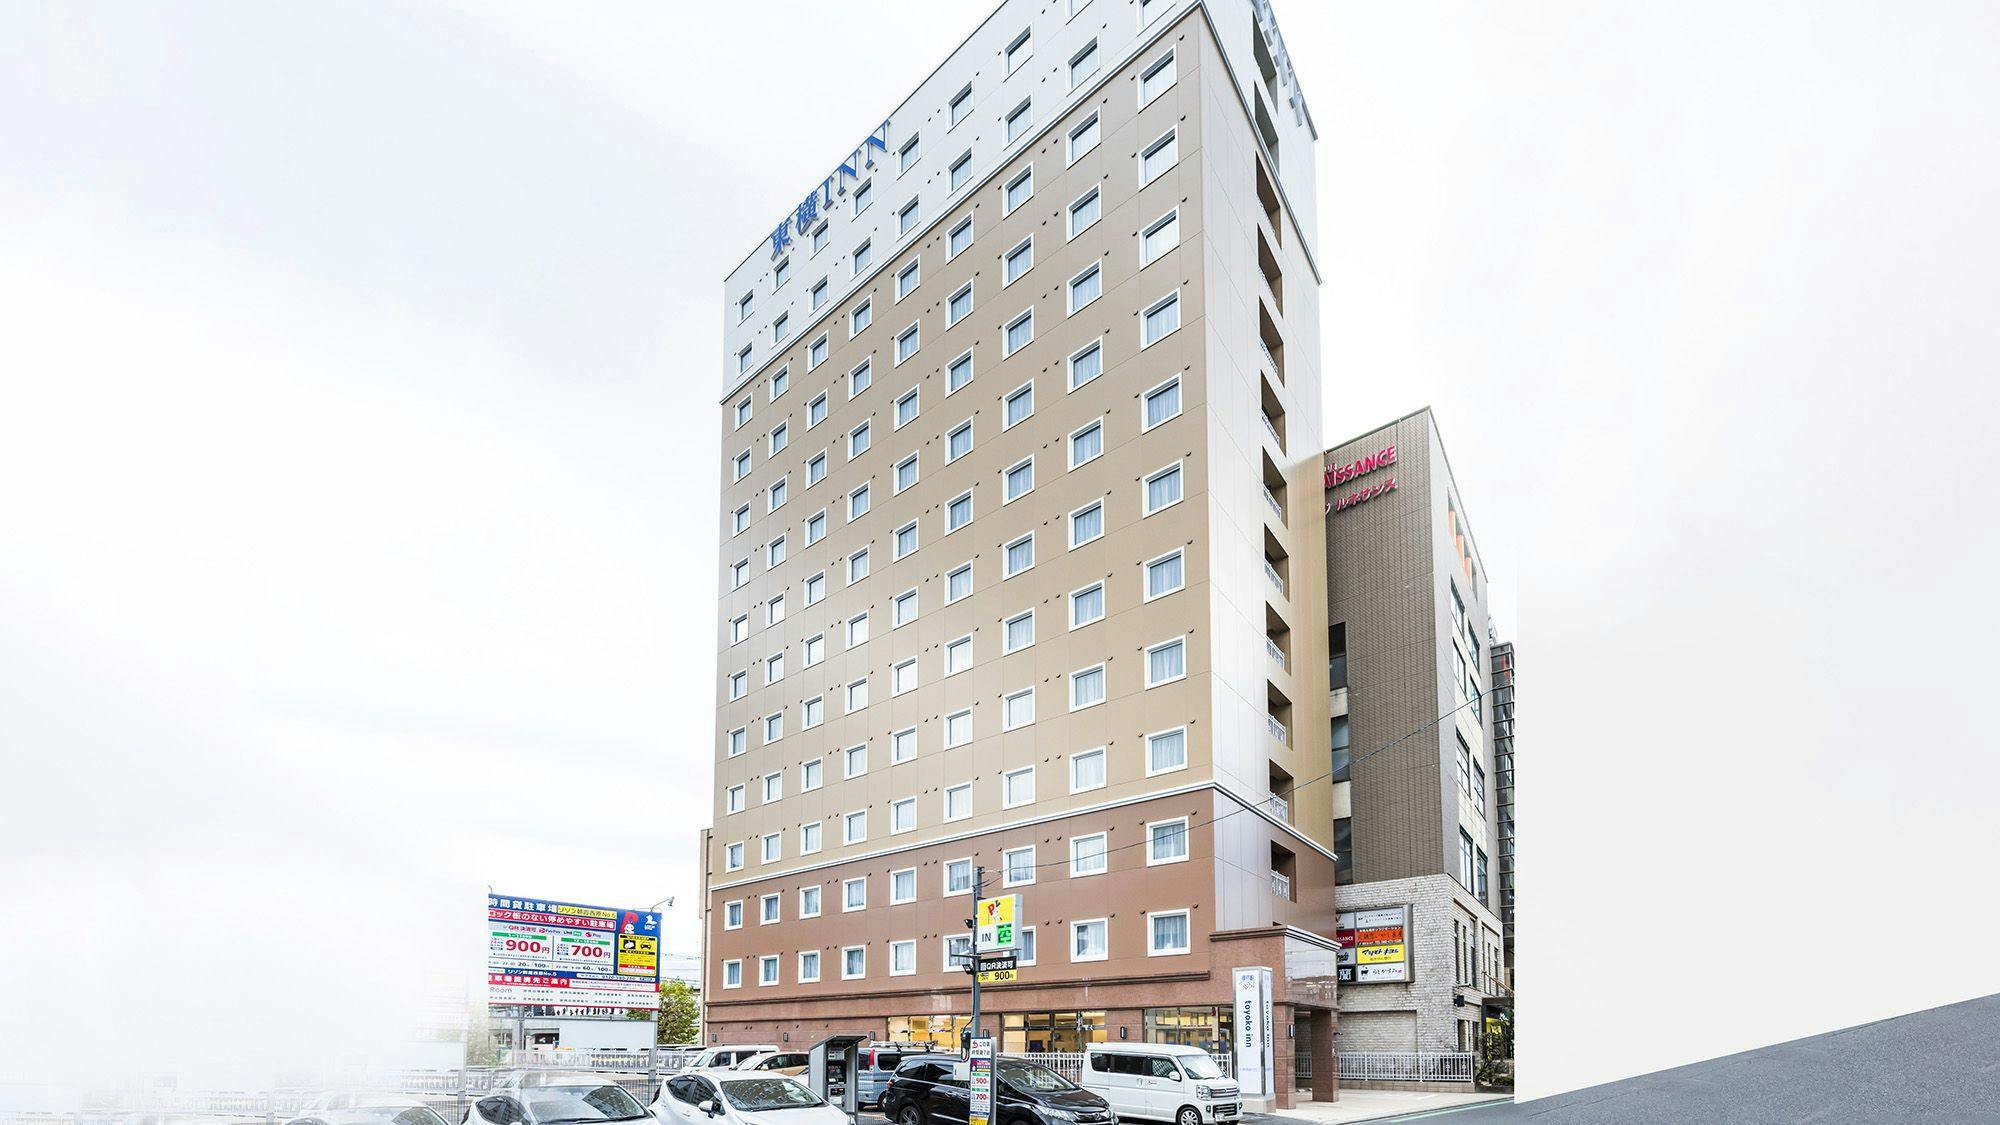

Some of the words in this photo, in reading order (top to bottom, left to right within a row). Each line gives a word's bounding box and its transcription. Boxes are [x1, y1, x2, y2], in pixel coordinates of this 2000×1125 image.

[770, 119, 890, 261] 東横INN
[982, 932, 992, 942] IN
[505, 939, 550, 954] 900円
[571, 945, 611, 958] 700円
[1244, 1000, 1252, 1032] toyoko
[1245, 1033, 1253, 1048] inn
